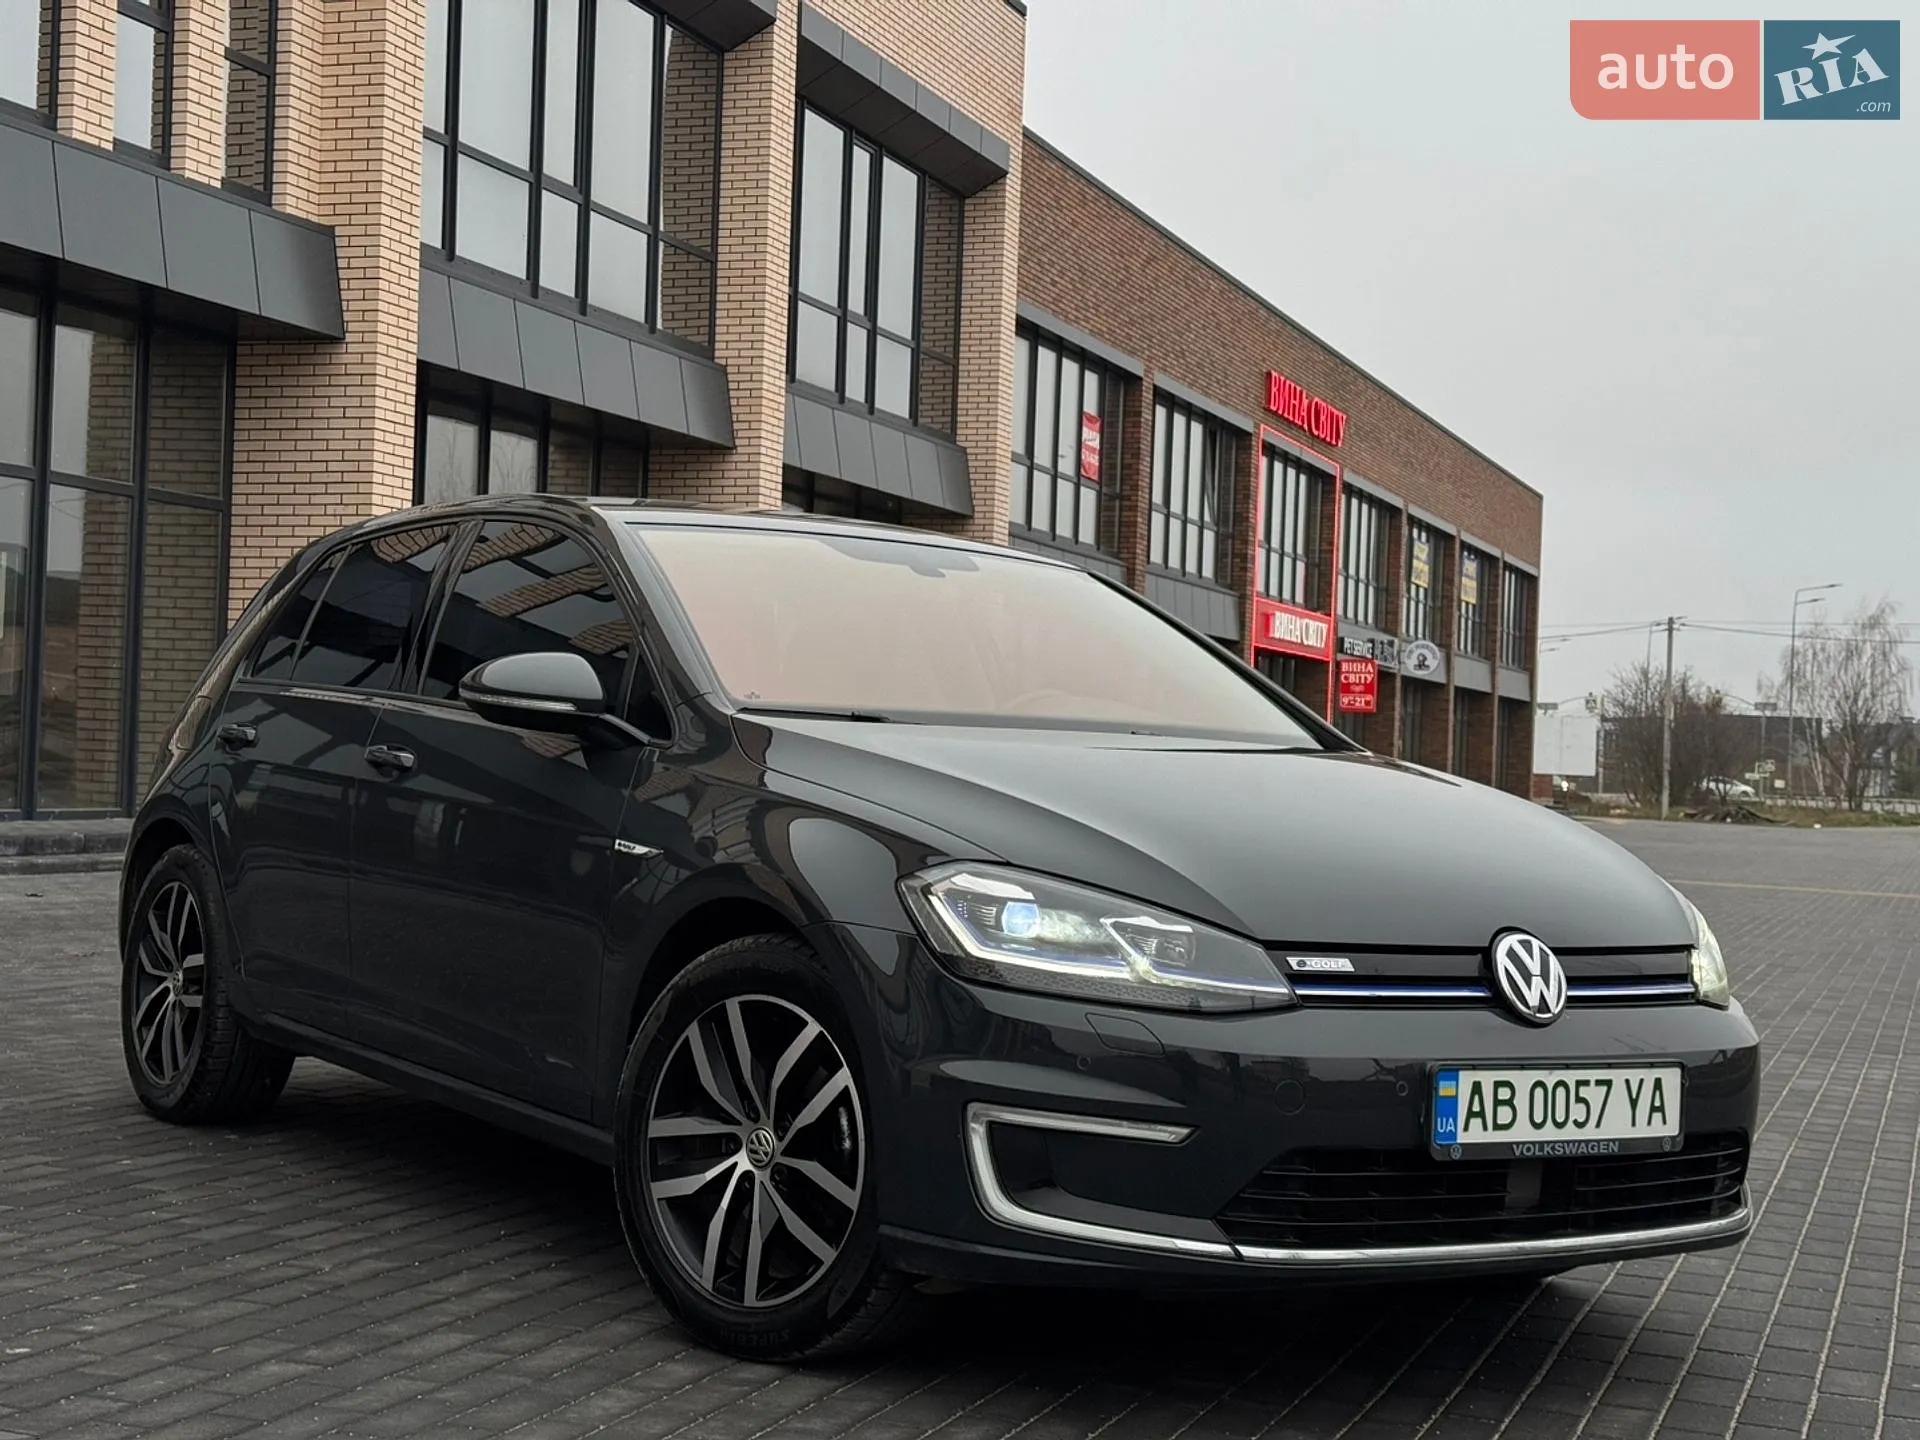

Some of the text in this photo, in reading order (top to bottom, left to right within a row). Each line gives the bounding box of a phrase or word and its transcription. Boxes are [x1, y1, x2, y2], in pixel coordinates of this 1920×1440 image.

[1269, 370, 1347, 447] ВИНА СВІТУ
[1274, 611, 1329, 648] ВИНА СВІТУ
[1341, 662, 1374, 672] ВИНА
[1341, 673, 1375, 684] СВІТУ
[1463, 1077, 1668, 1132] AB 0057 YA
[1437, 1117, 1455, 1133] UA
[1513, 1141, 1619, 1156] VOLKSWAGEN
